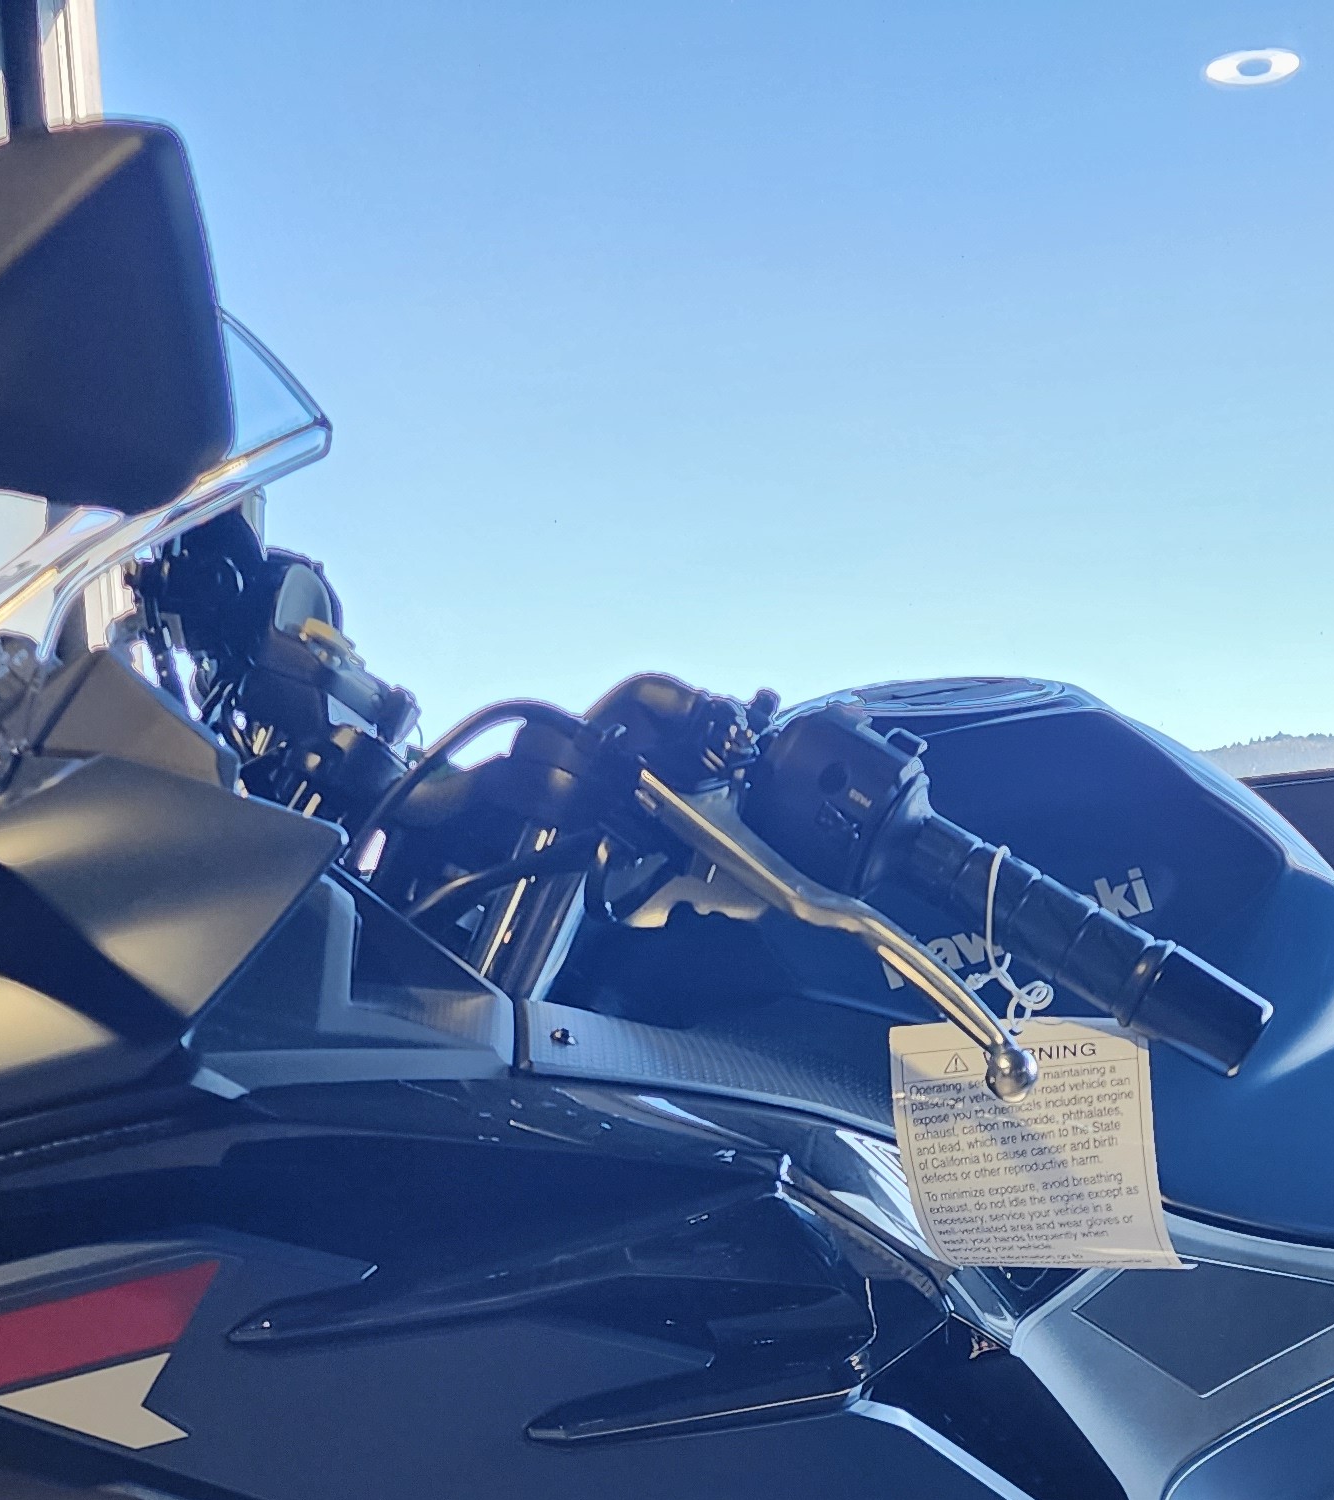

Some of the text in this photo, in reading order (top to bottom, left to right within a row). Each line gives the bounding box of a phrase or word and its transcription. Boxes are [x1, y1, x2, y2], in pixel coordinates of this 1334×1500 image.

[909, 1083, 965, 1097] Operating,
[1043, 1064, 1105, 1080] maintaining
[1110, 1065, 1116, 1074] a
[1069, 1077, 1107, 1091] vehicle
[1111, 1077, 1130, 1087] can
[913, 1114, 949, 1127] expose
[954, 1110, 971, 1123] you
[1045, 1094, 1093, 1108] including
[1097, 1090, 1134, 1104] engine
[917, 1143, 935, 1156] and
[968, 1135, 997, 1150] which
[1001, 1135, 1016, 1145] are
[1021, 1130, 1055, 1142] known
[1059, 1127, 1068, 1138] to
[1072, 1125, 1088, 1136] the
[1093, 1121, 1121, 1133] State
[919, 1135, 1118, 1171] of California to cause cancer and birth
[922, 1172, 957, 1184] defects
[961, 1171, 971, 1180] or
[975, 1165, 1000, 1179] other
[1005, 1158, 1067, 1176] reproductive
[925, 1191, 937, 1202] To
[941, 1187, 985, 1200] minimize
[1042, 1176, 1069, 1190] avoid
[1072, 1172, 1122, 1187] breathing
[975, 1200, 987, 1211] do
[991, 1199, 1005, 1209] not
[1010, 1196, 1026, 1207] idle
[1030, 1195, 1046, 1206] the
[1050, 1191, 1084, 1205] engine
[1088, 1187, 1121, 1200] except
[1126, 1185, 1138, 1195] as
